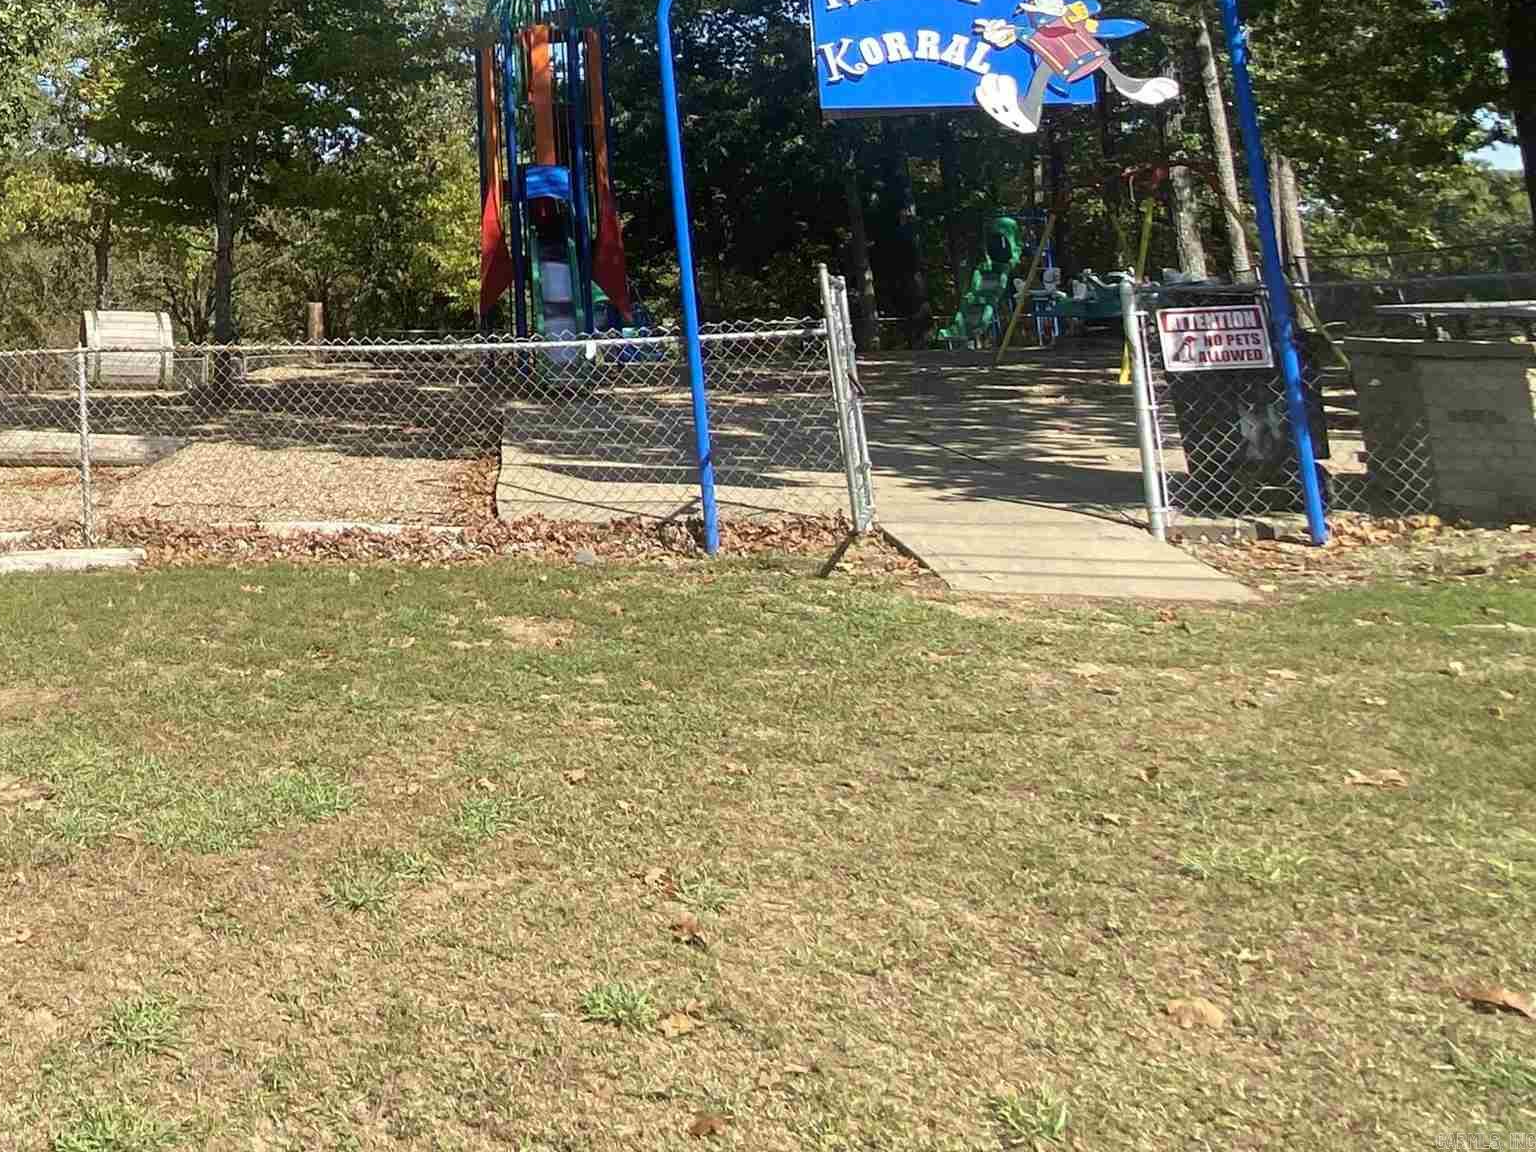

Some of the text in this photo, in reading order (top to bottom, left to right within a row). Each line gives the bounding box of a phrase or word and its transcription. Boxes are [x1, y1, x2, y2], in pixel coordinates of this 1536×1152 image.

[818, 29, 991, 82] KORRAL
[1166, 311, 1257, 331] ATTENTION
[1204, 333, 1261, 347] NO PETS
[1199, 349, 1263, 362] ALLOWED
